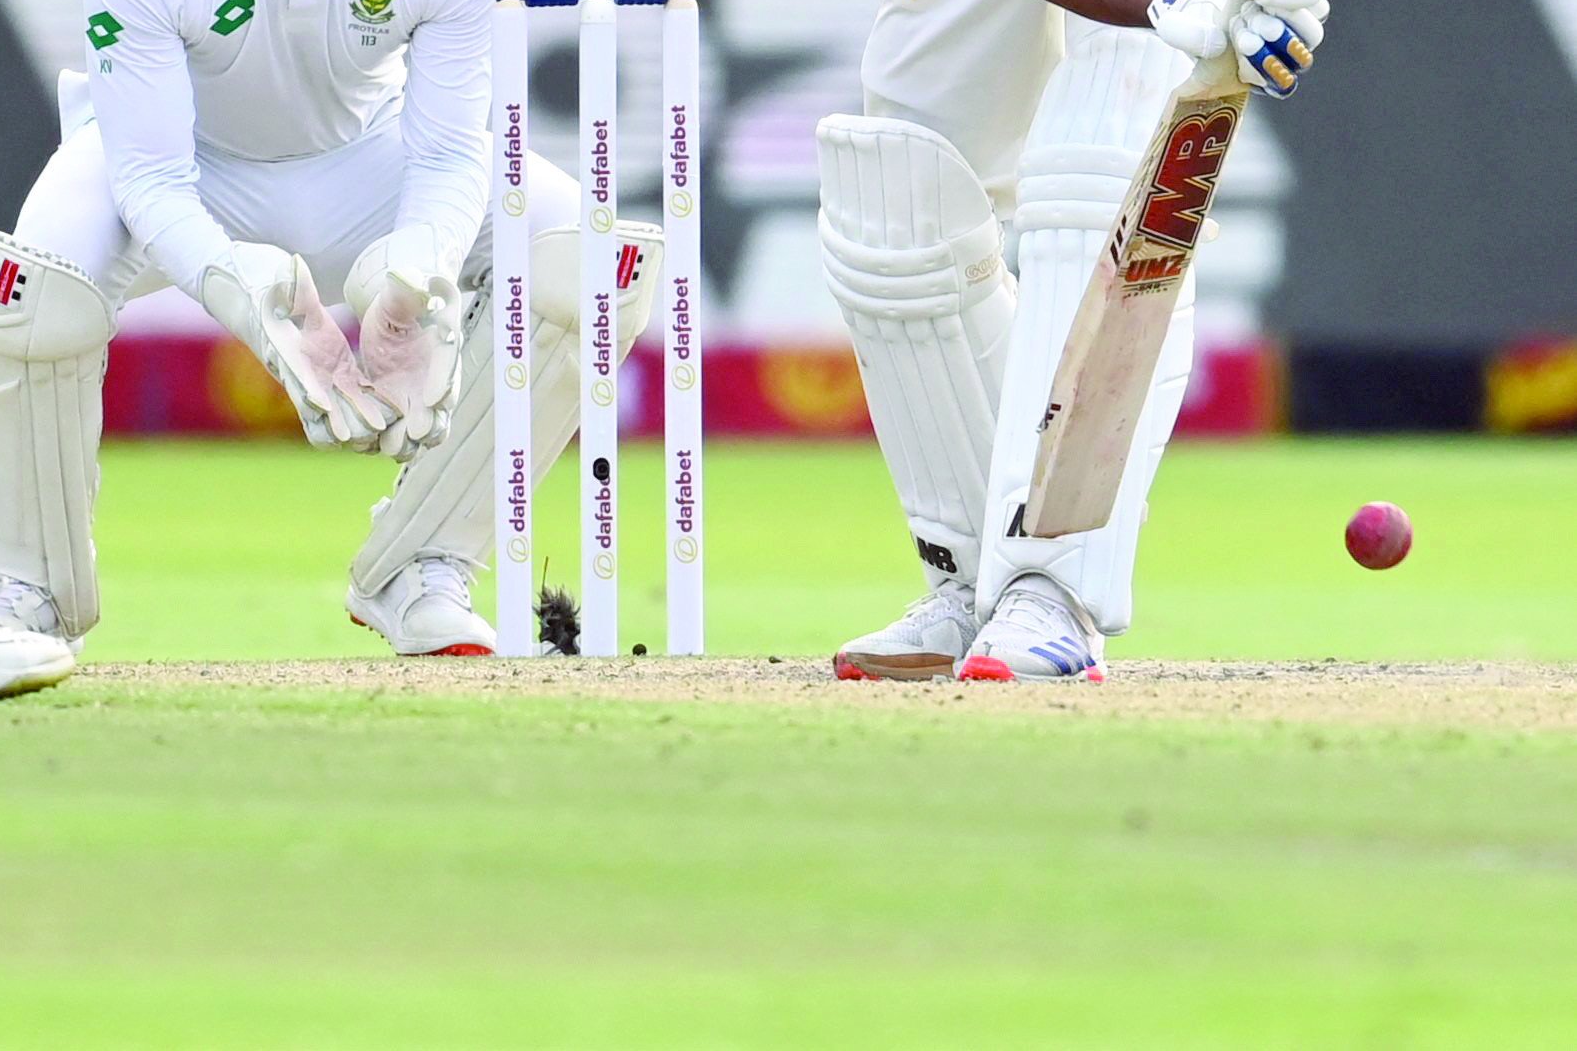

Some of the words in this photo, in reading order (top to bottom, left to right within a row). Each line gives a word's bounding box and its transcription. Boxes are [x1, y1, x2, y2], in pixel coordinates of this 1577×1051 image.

[100, 58, 113, 75] KV
[348, 23, 389, 35] PROTEAS
[360, 35, 377, 47] 113
[504, 103, 523, 186] dafabet
[591, 119, 611, 203] dafabet
[671, 105, 690, 187] dafabet
[1136, 106, 1237, 250] MB
[1124, 252, 1187, 283] UMZ
[506, 276, 525, 359] dafabet
[592, 293, 612, 376] dafabet
[672, 277, 691, 360] dafabet
[508, 449, 527, 532] dafabet
[594, 475, 614, 549] dafab
[675, 450, 694, 533] dafabet
